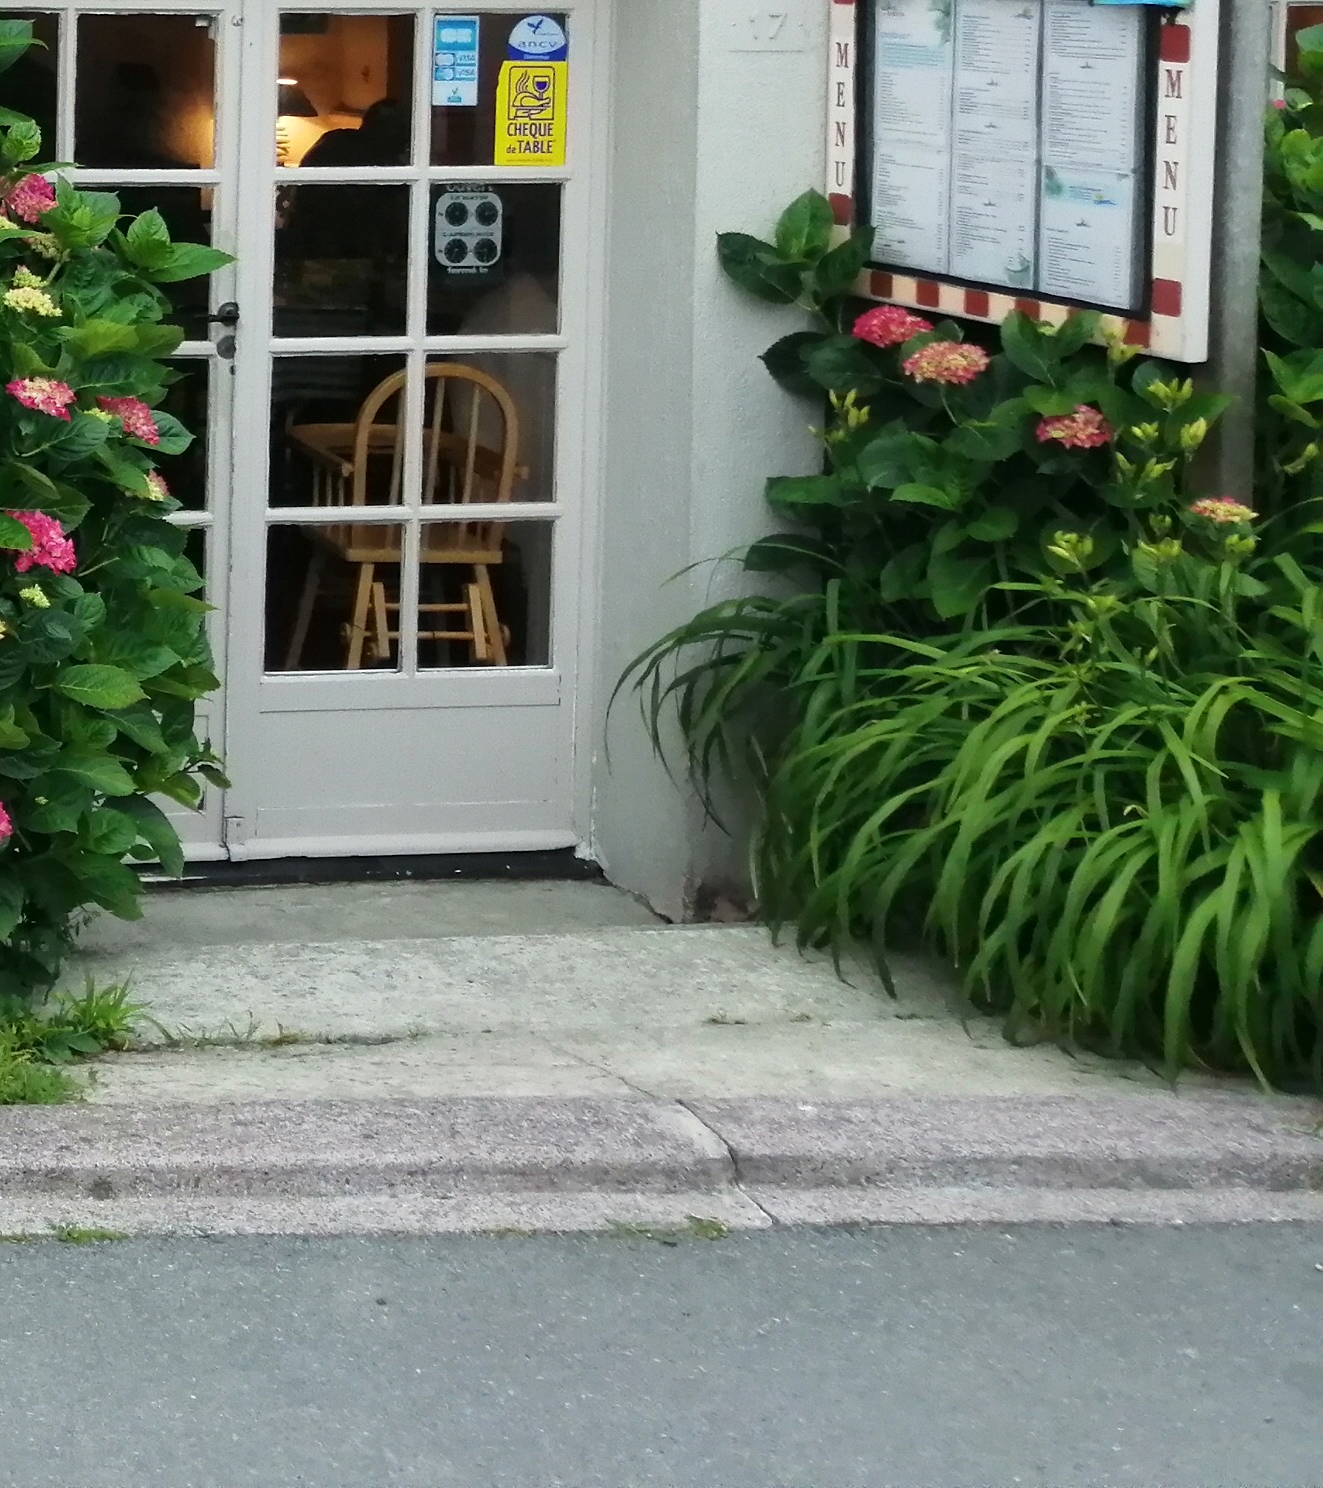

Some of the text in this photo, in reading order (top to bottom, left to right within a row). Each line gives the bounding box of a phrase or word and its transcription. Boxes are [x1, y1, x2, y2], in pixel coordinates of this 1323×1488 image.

[506, 140, 553, 154] de TABLE
[507, 122, 554, 139] CHEQUE
[835, 42, 849, 188] MENU
[1163, 69, 1184, 237] MENU
